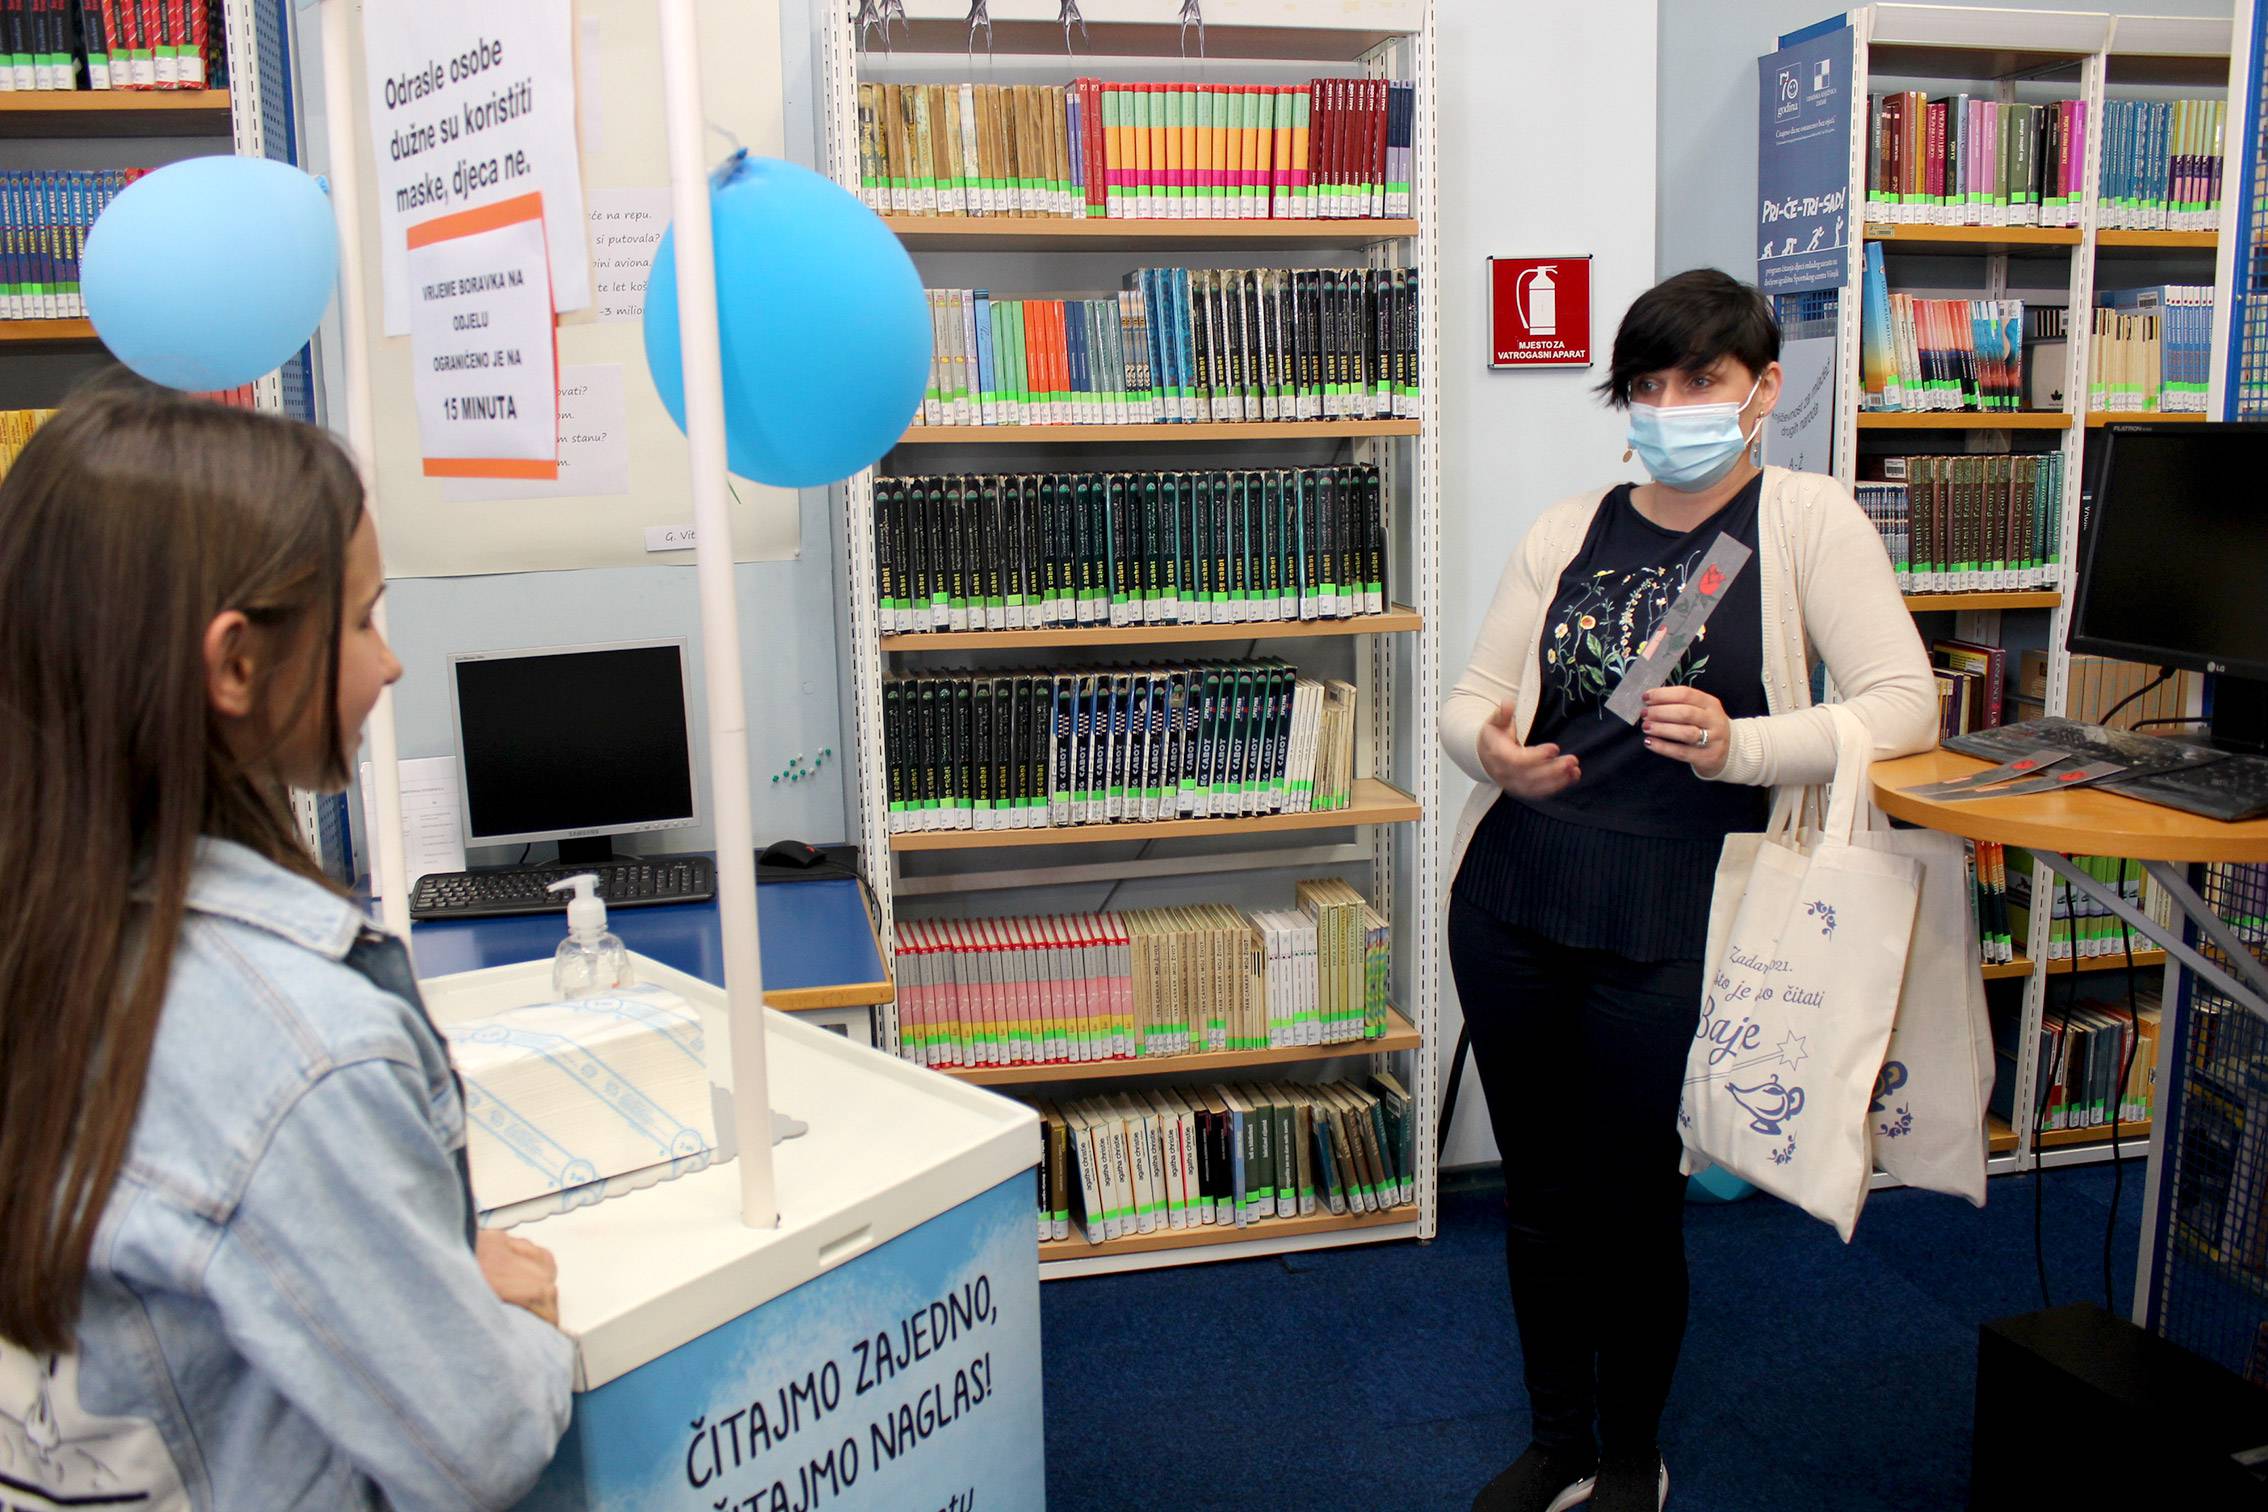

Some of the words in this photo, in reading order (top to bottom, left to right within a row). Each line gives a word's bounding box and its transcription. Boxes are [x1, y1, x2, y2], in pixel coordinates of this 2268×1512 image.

[385, 60, 444, 110] Odrasle
[450, 38, 503, 83] osobe
[390, 123, 436, 162] dužne
[440, 116, 459, 144] su
[464, 78, 533, 135] koristiti
[396, 172, 449, 213] maske,
[453, 159, 498, 199] djeca
[505, 150, 531, 180] ne.
[606, 212, 620, 220] na
[624, 211, 652, 222] repu.
[596, 234, 605, 244] si
[608, 233, 661, 246] putovala?
[422, 278, 457, 301] VRIJEME
[458, 273, 506, 297] BORAVKA
[507, 269, 525, 287] NA
[612, 281, 626, 292] let
[630, 281, 648, 292] koš
[452, 312, 489, 331] ODJELU
[616, 305, 645, 316] milio
[1498, 351, 1552, 359] VATROGASNI
[1552, 350, 1586, 359] APARAT
[1518, 341, 1553, 349] MJESTO
[1553, 340, 1565, 349] ZA
[492, 350, 504, 368] JE
[507, 349, 522, 367] NA
[1198, 356, 1206, 380] cabot
[1340, 355, 1348, 380] cabot
[1396, 353, 1404, 378] cabot
[443, 397, 458, 421] 15
[461, 395, 518, 421] MINUTA
[571, 433, 607, 444] stanu?
[680, 529, 696, 541] Vit
[881, 567, 891, 593] cabot
[1046, 563, 1054, 585] cabot
[1063, 562, 1071, 585] cabot
[1059, 747, 1067, 779] CABOT
[1096, 744, 1104, 776] CABOT
[1114, 744, 1122, 775] CABOT
[1132, 743, 1140, 774] CABOT
[1150, 743, 1159, 774] CABOT
[1169, 741, 1178, 772] CABOT
[1186, 740, 1195, 771] CABOT
[1200, 738, 1211, 770] CABOT
[1216, 738, 1226, 770] CABOT
[1232, 738, 1242, 770] CABOT
[1248, 738, 1258, 769] CABOT
[1264, 738, 1273, 769] CABOT
[1277, 735, 1286, 766] CABOT
[1729, 946, 1770, 974] Zadar
[1769, 960, 1793, 972] 021.
[1725, 980, 1751, 1002] je
[1783, 985, 1825, 1008] čitati
[1099, 1138, 1107, 1163] christie
[1113, 1134, 1122, 1159] christie
[1133, 1132, 1141, 1157] christie
[1149, 1129, 1157, 1154] christie
[1184, 1127, 1192, 1152] christie
[1080, 1142, 1089, 1167] christie
[1152, 1155, 1160, 1178] agatha
[1170, 1154, 1178, 1177] agatha
[1186, 1152, 1194, 1175] agatha
[1084, 1167, 1092, 1190] agatha
[1103, 1164, 1111, 1187] agatha
[1117, 1160, 1126, 1183] agatha
[1136, 1158, 1144, 1181] agatha
[687, 1359, 840, 1489] ČITAJMO
[852, 1274, 998, 1396] ZAJEDNO,
[870, 1352, 993, 1472] NAGLAS!
